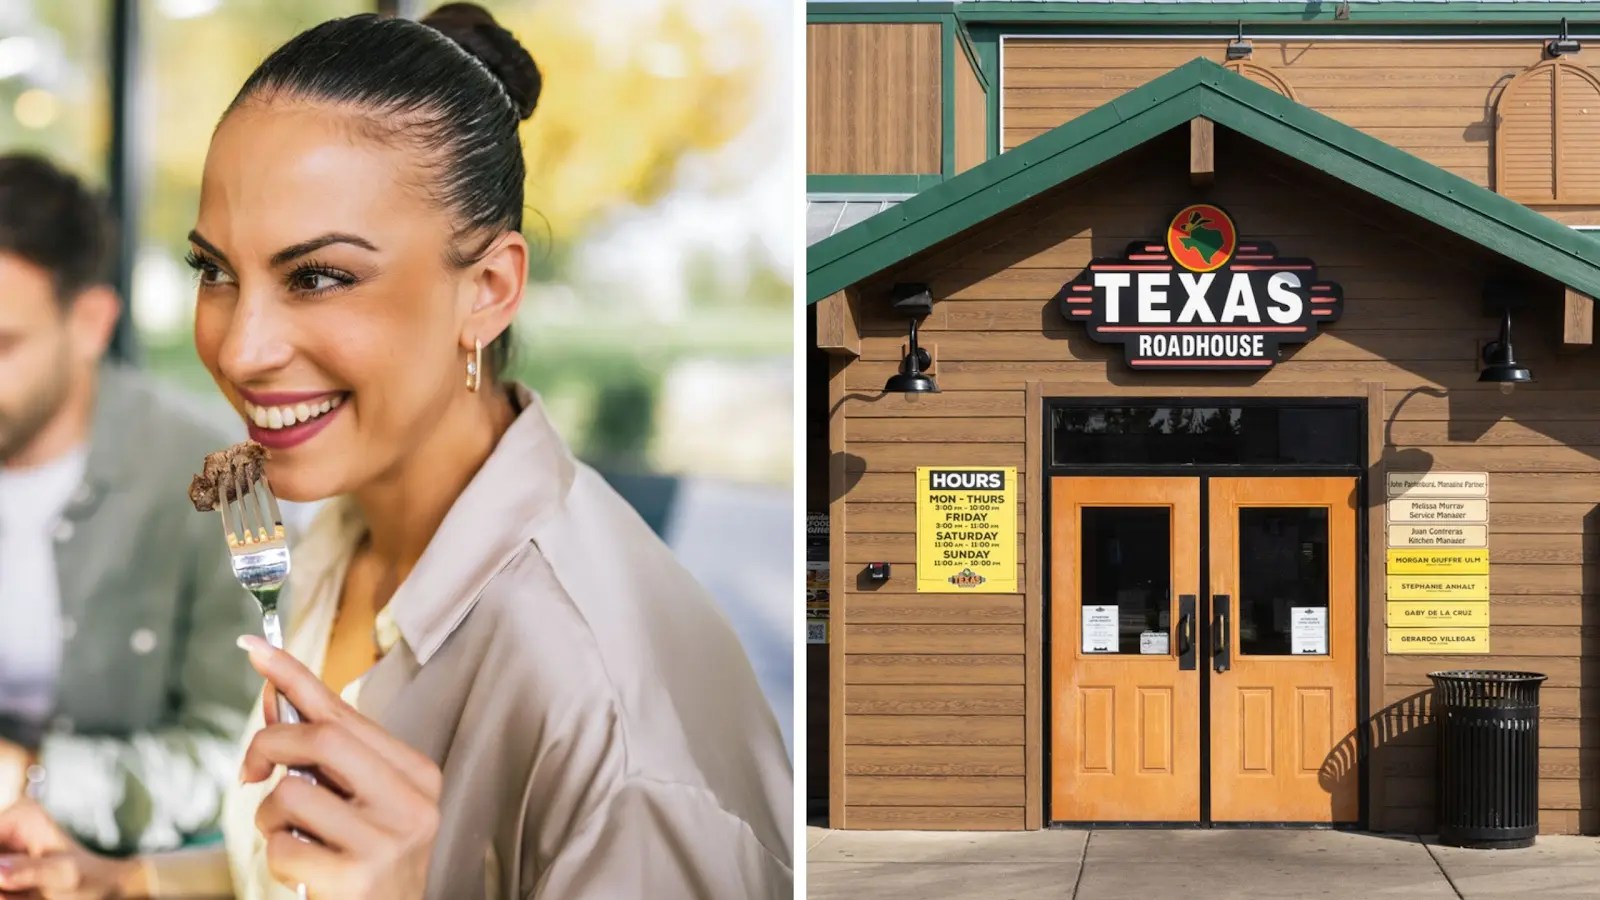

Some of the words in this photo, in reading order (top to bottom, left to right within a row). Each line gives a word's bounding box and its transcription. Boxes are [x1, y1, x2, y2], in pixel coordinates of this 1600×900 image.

[1094, 272, 1303, 324] TEXAS
[1139, 334, 1264, 357] ROADHOUSE
[933, 473, 1001, 488] HOURS
[929, 495, 956, 504] MON
[967, 495, 1005, 504] THURS
[1411, 502, 1437, 510] Melissa
[1438, 502, 1465, 511] Murray
[945, 513, 988, 522] FRIDAY
[1436, 512, 1467, 520] Manager
[936, 532, 998, 540] SATURDAY
[1435, 537, 1466, 545] Manager
[943, 551, 990, 559] SUNDAY
